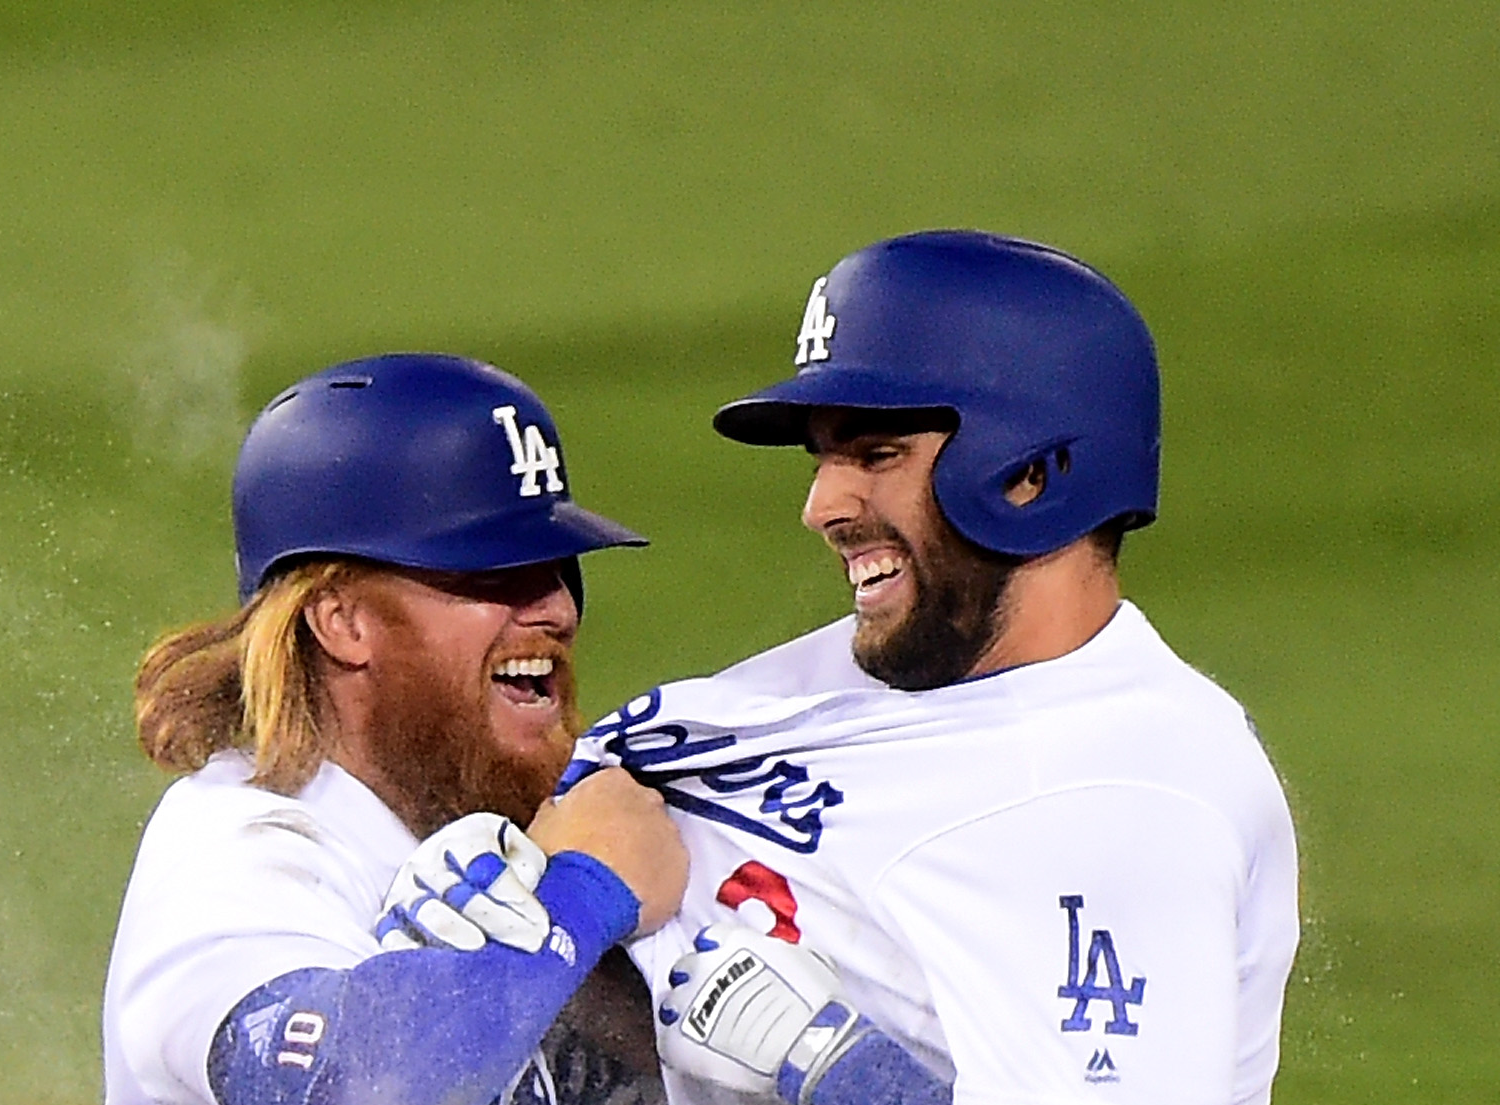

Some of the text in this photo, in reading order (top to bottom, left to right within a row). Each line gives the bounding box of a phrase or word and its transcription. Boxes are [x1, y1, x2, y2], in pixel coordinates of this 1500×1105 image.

[794, 276, 836, 365] LA
[492, 405, 564, 497] LA
[1057, 895, 1147, 1036] LA
[278, 1011, 326, 1069] 10
